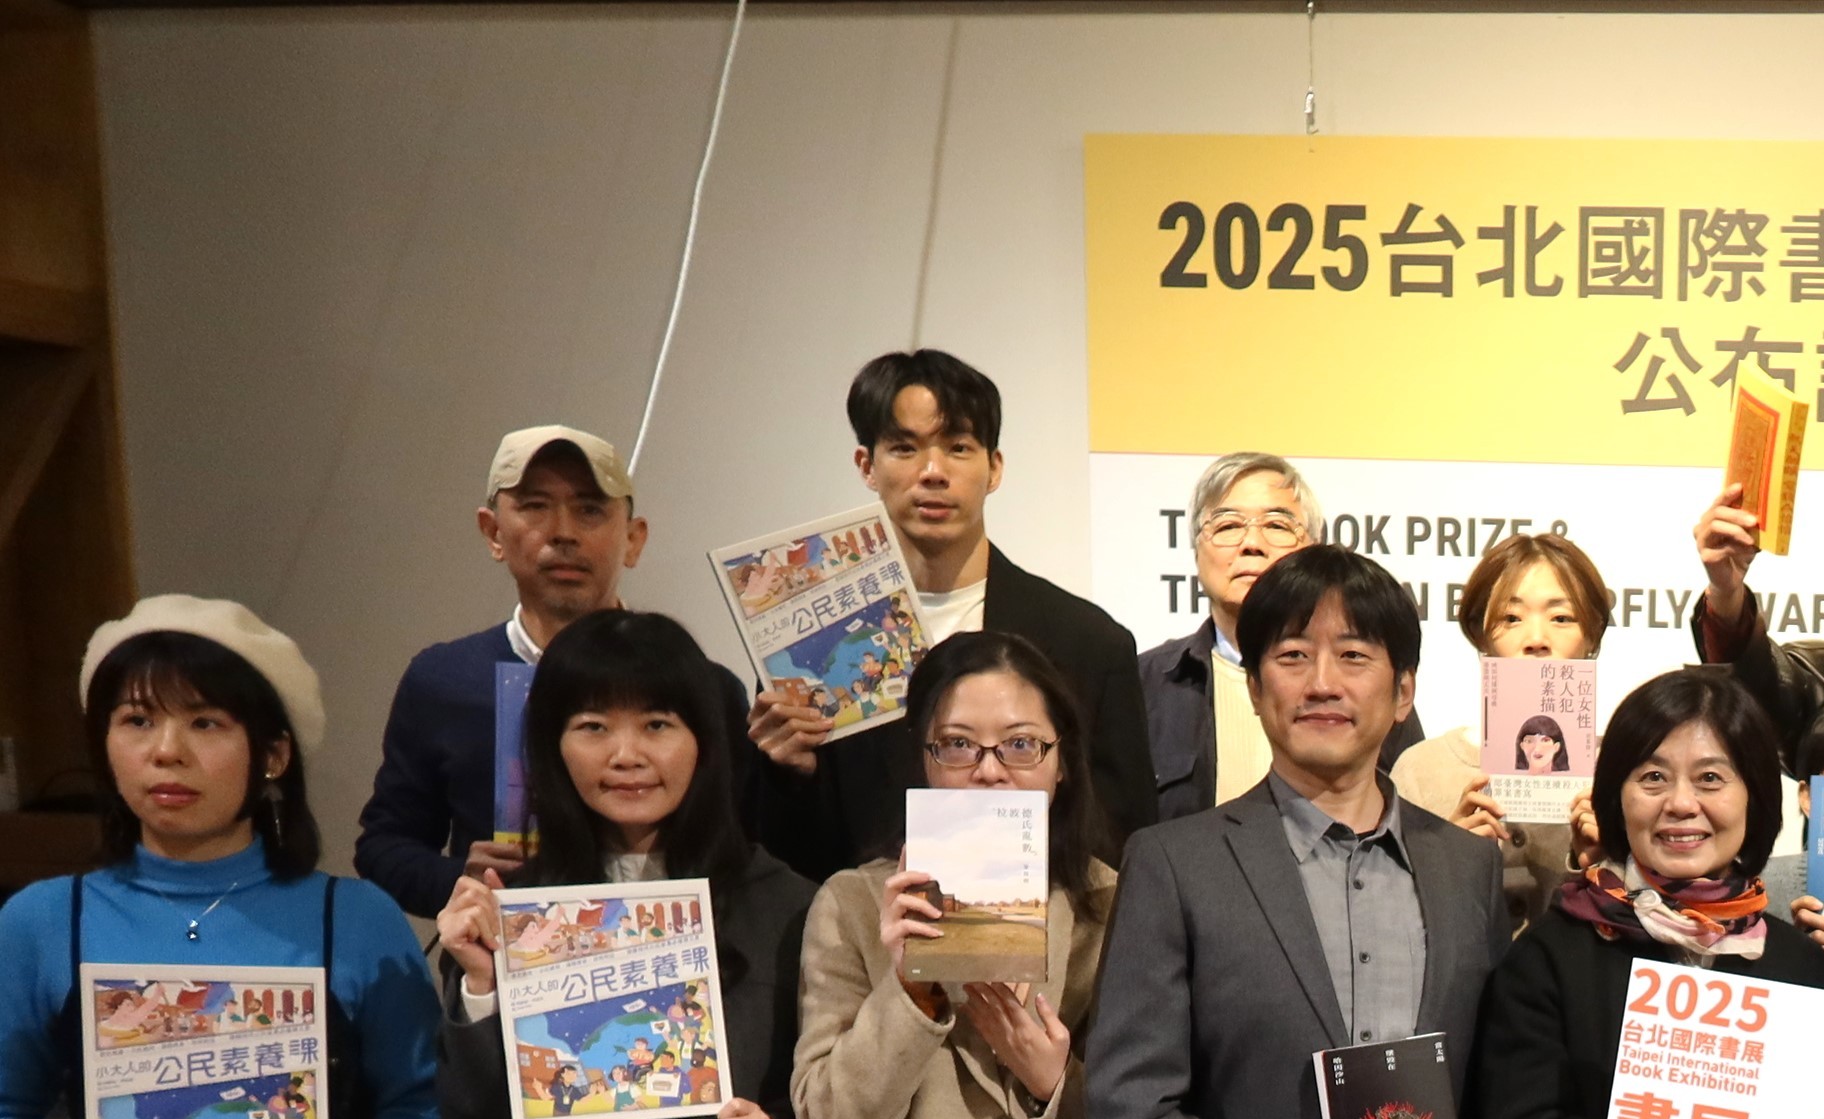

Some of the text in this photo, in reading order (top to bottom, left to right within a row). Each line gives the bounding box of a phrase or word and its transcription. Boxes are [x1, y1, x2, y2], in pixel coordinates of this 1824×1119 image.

[1321, 514, 1391, 555] OK
[1540, 663, 1556, 713] 的素描
[1559, 664, 1575, 713] 殺人犯
[1576, 669, 1593, 729] 一位女性
[1627, 968, 1771, 1033] 2025
[1622, 1045, 1760, 1080] Taipei International
[1623, 1020, 1765, 1064] 台北國際書展
[1619, 1059, 1757, 1097] Book Exhibition
